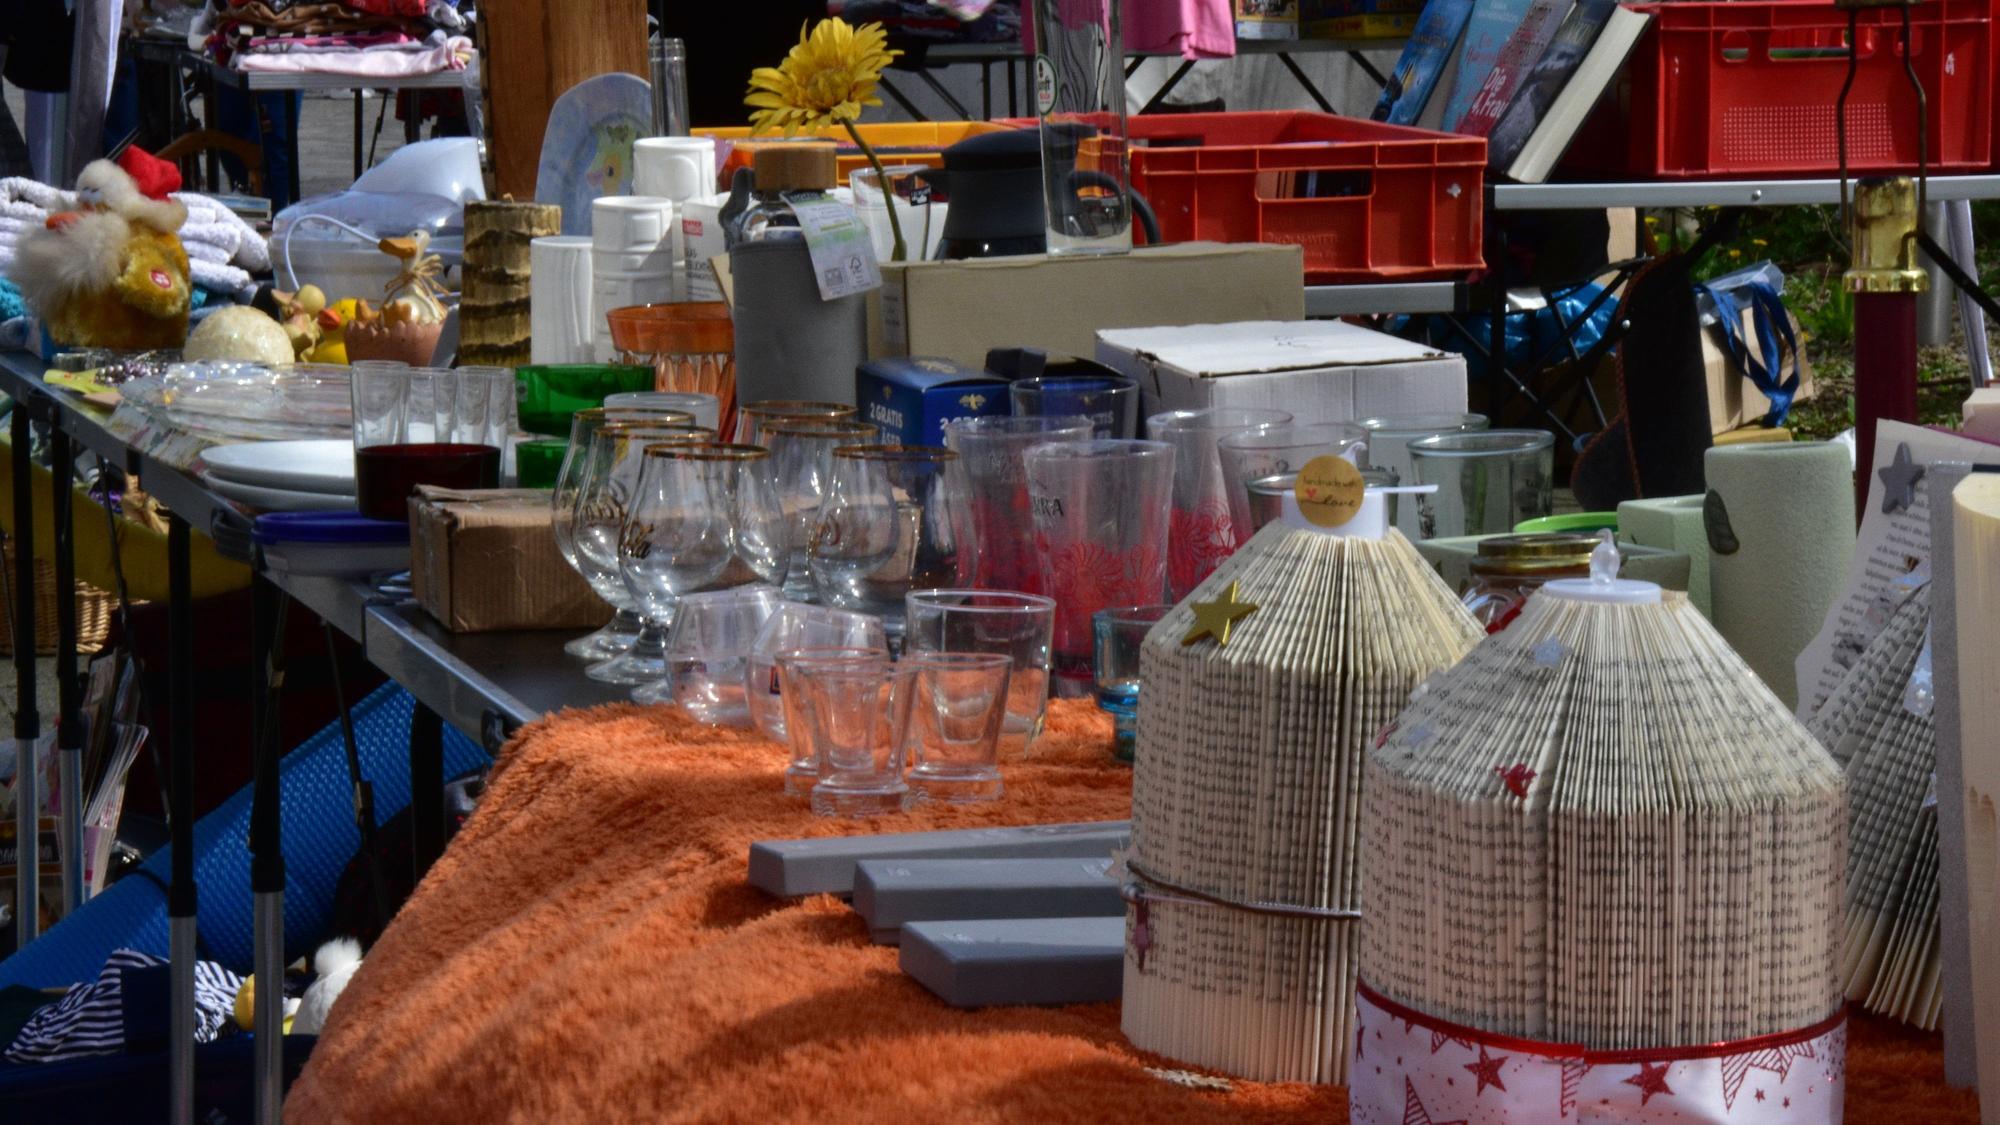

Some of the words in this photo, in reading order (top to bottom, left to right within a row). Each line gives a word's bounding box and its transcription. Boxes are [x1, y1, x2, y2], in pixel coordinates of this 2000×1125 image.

[1483, 66, 1507, 93] Die
[1479, 92, 1510, 119] Frau
[869, 401, 877, 419] 2
[876, 404, 904, 430] GRATIS
